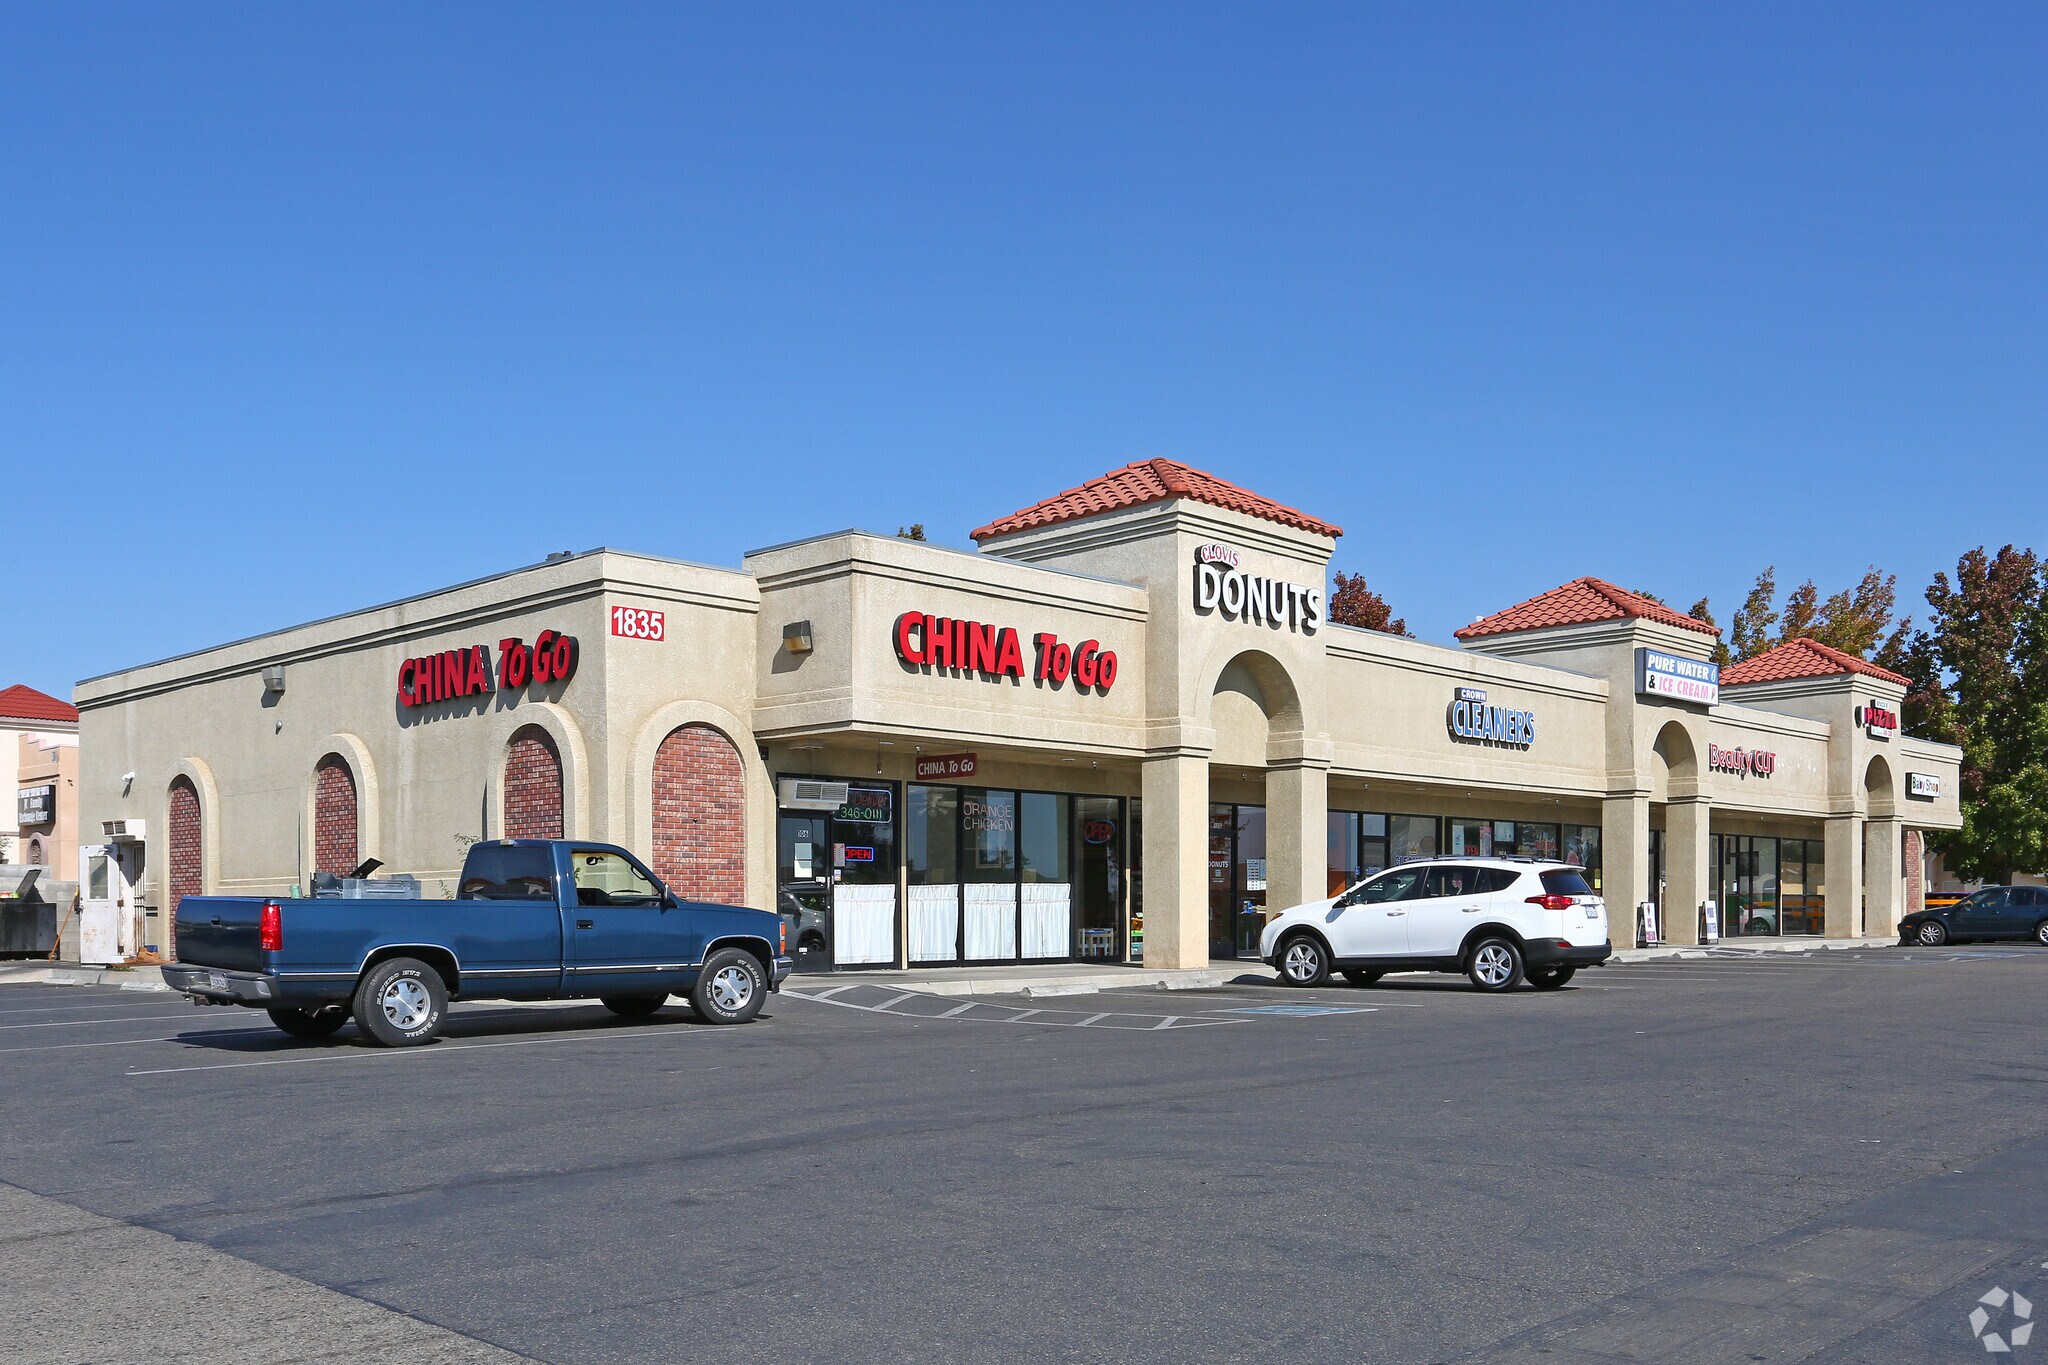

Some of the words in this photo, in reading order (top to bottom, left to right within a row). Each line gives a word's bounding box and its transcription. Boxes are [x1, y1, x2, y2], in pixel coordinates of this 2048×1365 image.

[1201, 545, 1239, 567] CLOVIS
[1198, 563, 1321, 629] DONUTS
[613, 607, 663, 640] 1835
[898, 610, 1026, 677] CHINA
[1038, 632, 1072, 682] To
[1077, 639, 1118, 689] Go
[397, 643, 490, 707] CHINA
[499, 637, 528, 690] To
[532, 629, 574, 684] Go
[1648, 653, 1675, 673] PURE
[1677, 660, 1709, 680] WATER
[1461, 688, 1486, 701] CROWN
[1648, 674, 1656, 689] &
[1658, 676, 1674, 693] ICE
[1677, 680, 1709, 700] CREAM
[1453, 700, 1535, 745] CLEANERS
[1866, 707, 1897, 730] PIZZA
[918, 761, 946, 776] CHINA
[949, 760, 959, 773] To
[960, 759, 974, 772] Go
[1710, 743, 1752, 774] Beauty
[1754, 748, 1776, 774] CUT
[1912, 776, 1925, 794] Baby
[1925, 779, 1939, 796] Shop
[840, 806, 882, 820] 346-0111
[963, 802, 1012, 818] ORANGE
[963, 816, 1013, 832] CHICKEN
